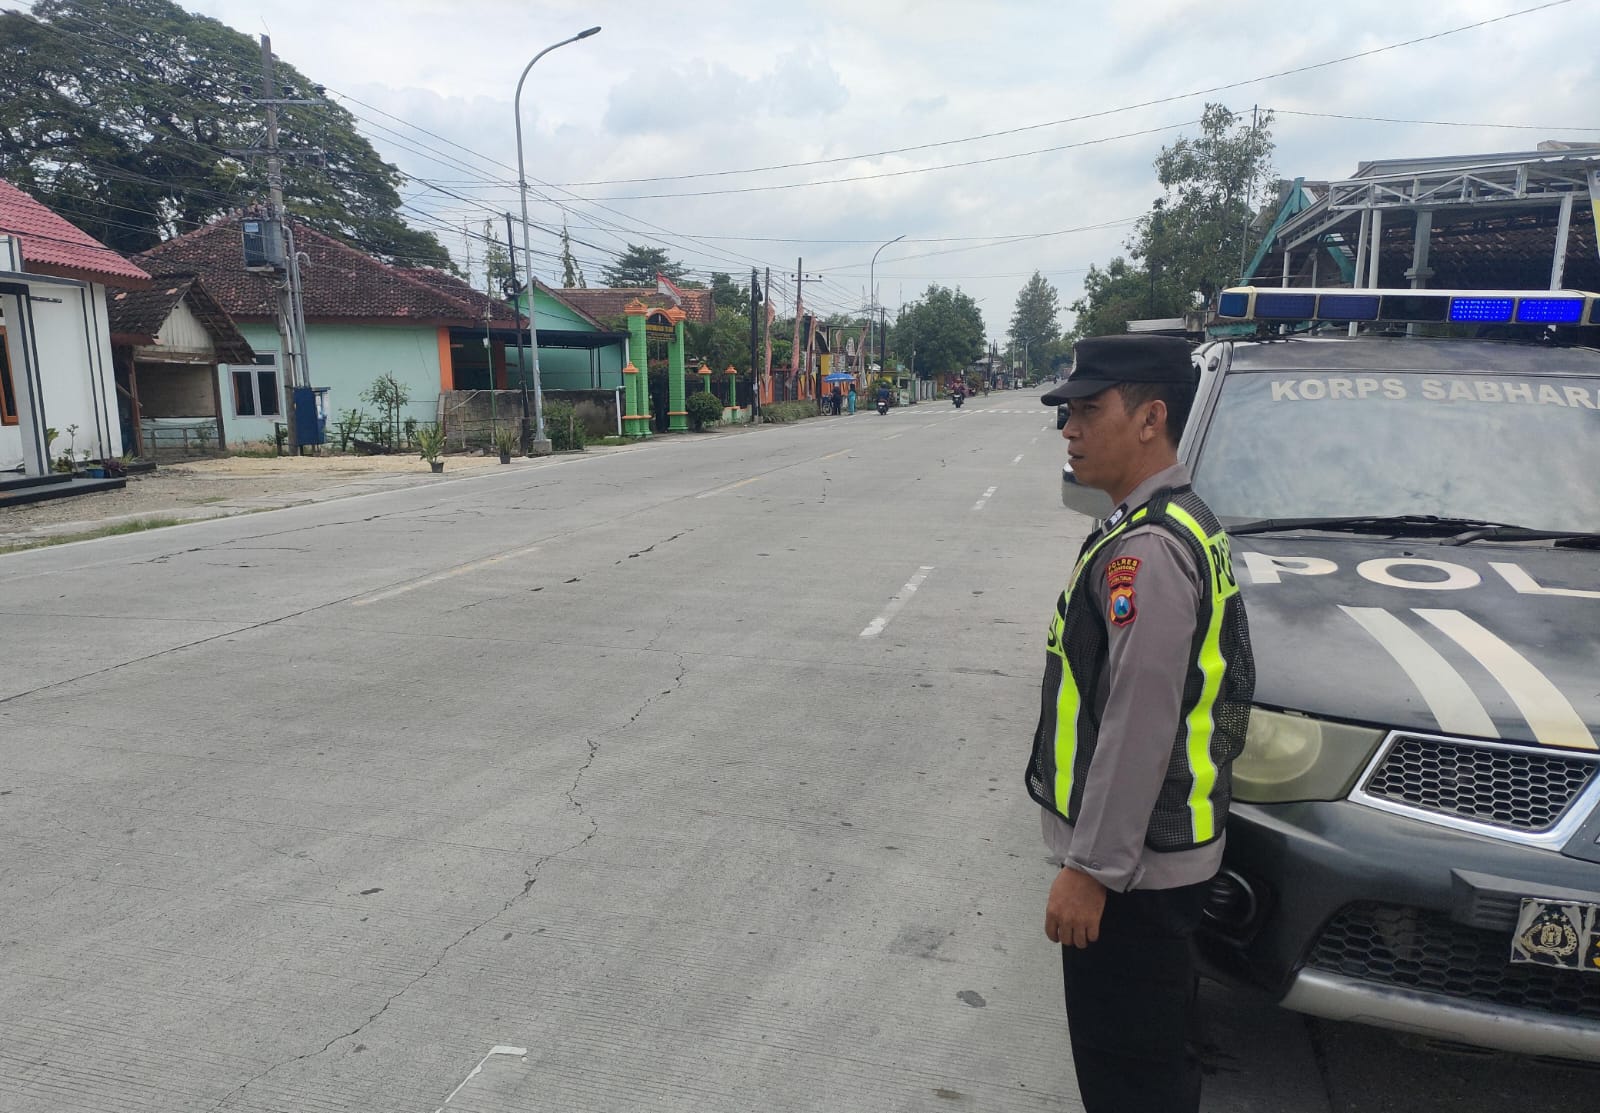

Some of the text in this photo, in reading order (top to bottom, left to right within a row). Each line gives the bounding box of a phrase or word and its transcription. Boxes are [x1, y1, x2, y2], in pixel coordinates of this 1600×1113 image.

[1271, 378, 1600, 409] KORPS SABHAR
[1108, 558, 1138, 572] POLRES
[1242, 551, 1600, 599] POL
